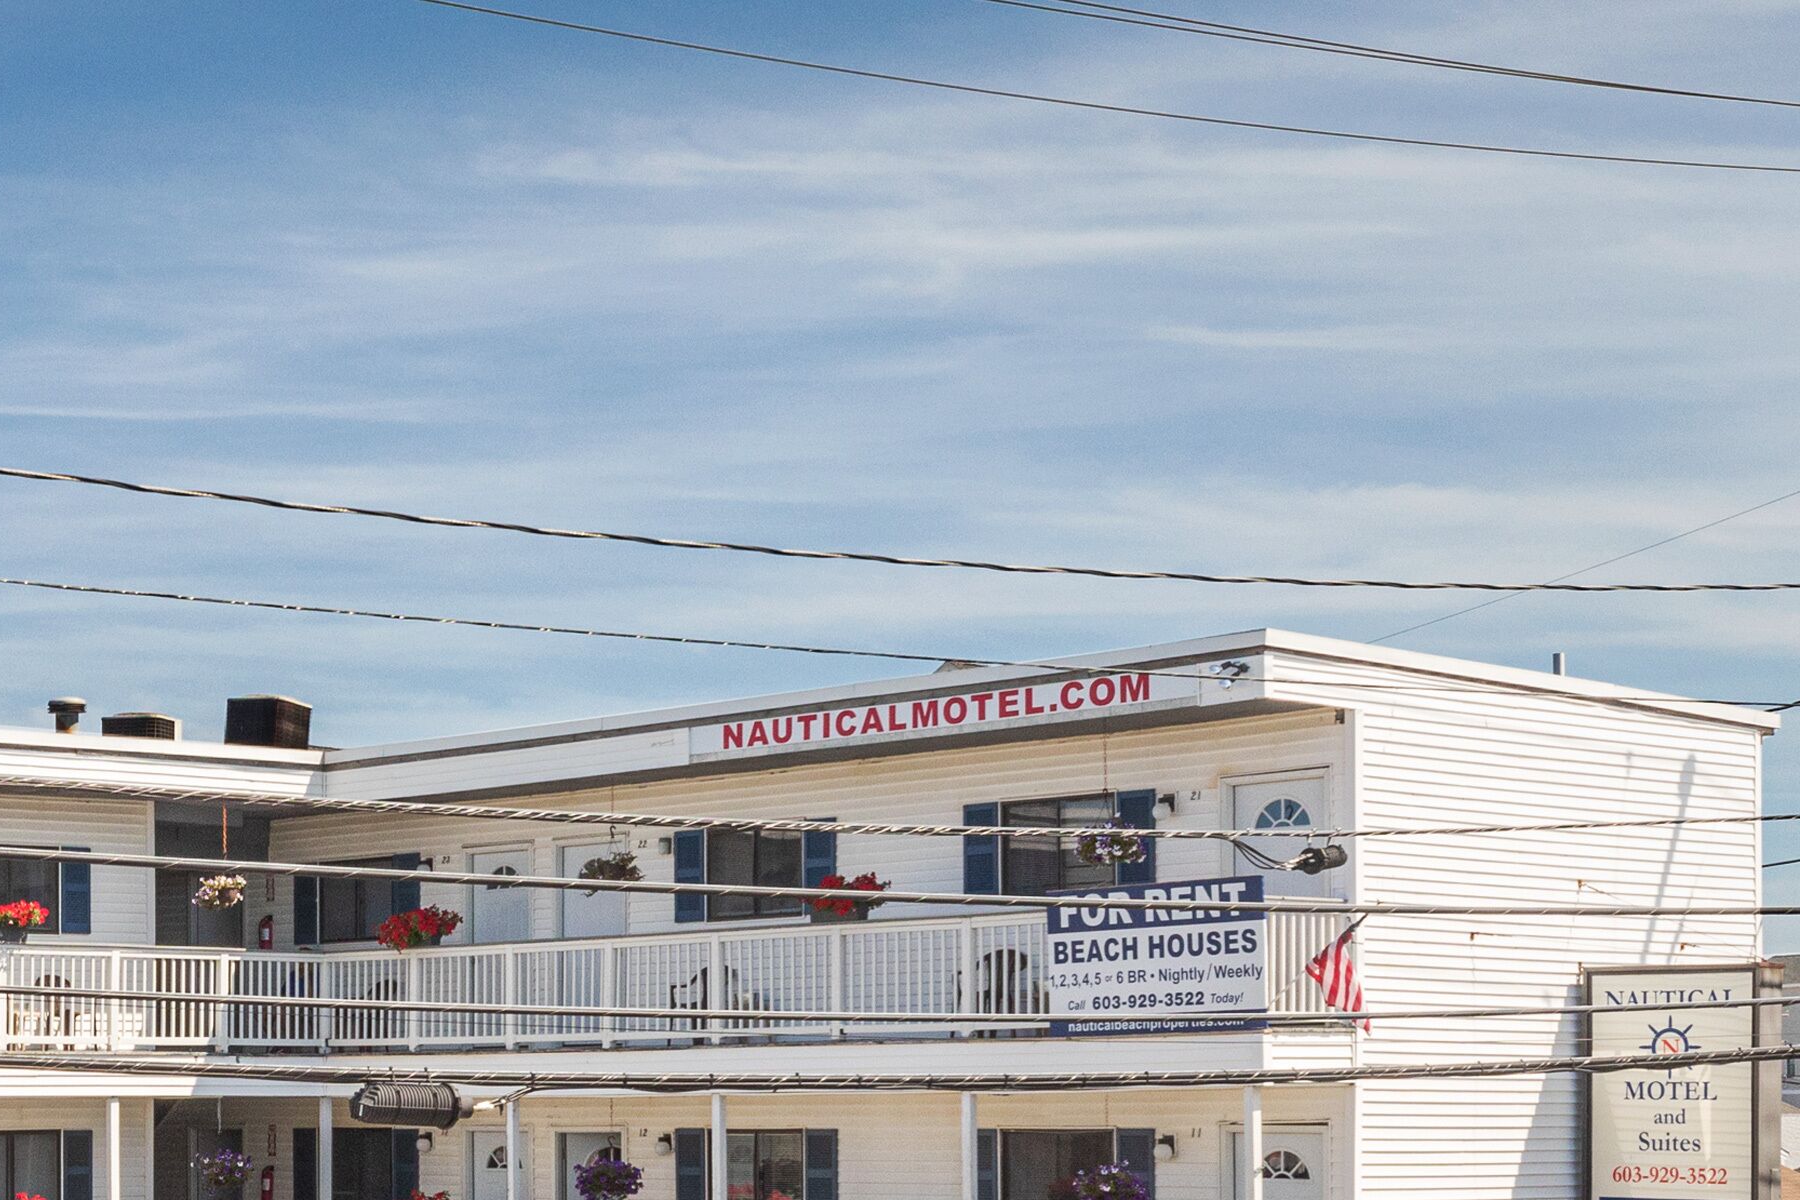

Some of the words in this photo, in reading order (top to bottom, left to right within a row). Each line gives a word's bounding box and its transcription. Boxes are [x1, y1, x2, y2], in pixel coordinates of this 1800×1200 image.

[722, 673, 1151, 749] NAUTICALMOTEL.COM
[1190, 791, 1201, 800] 21
[638, 840, 647, 849] 22
[1060, 892, 1133, 928] FOR
[1145, 882, 1246, 922] RENT
[1054, 937, 1138, 964] BEACH
[1149, 929, 1257, 958] HOUSES
[1116, 973, 1124, 984] 6
[1128, 970, 1147, 984] BR
[1068, 1000, 1086, 1011] Call
[1092, 991, 1205, 1010] 603-929-3522
[1210, 992, 1244, 1005] Today!
[1605, 989, 1733, 1006] NAUTICAL
[1624, 1081, 1717, 1101] MOTEL
[1654, 1109, 1686, 1124] and
[1191, 1128, 1201, 1138] 11
[1638, 1131, 1701, 1152] Suites
[1612, 1166, 1728, 1185] 603-929-3522
